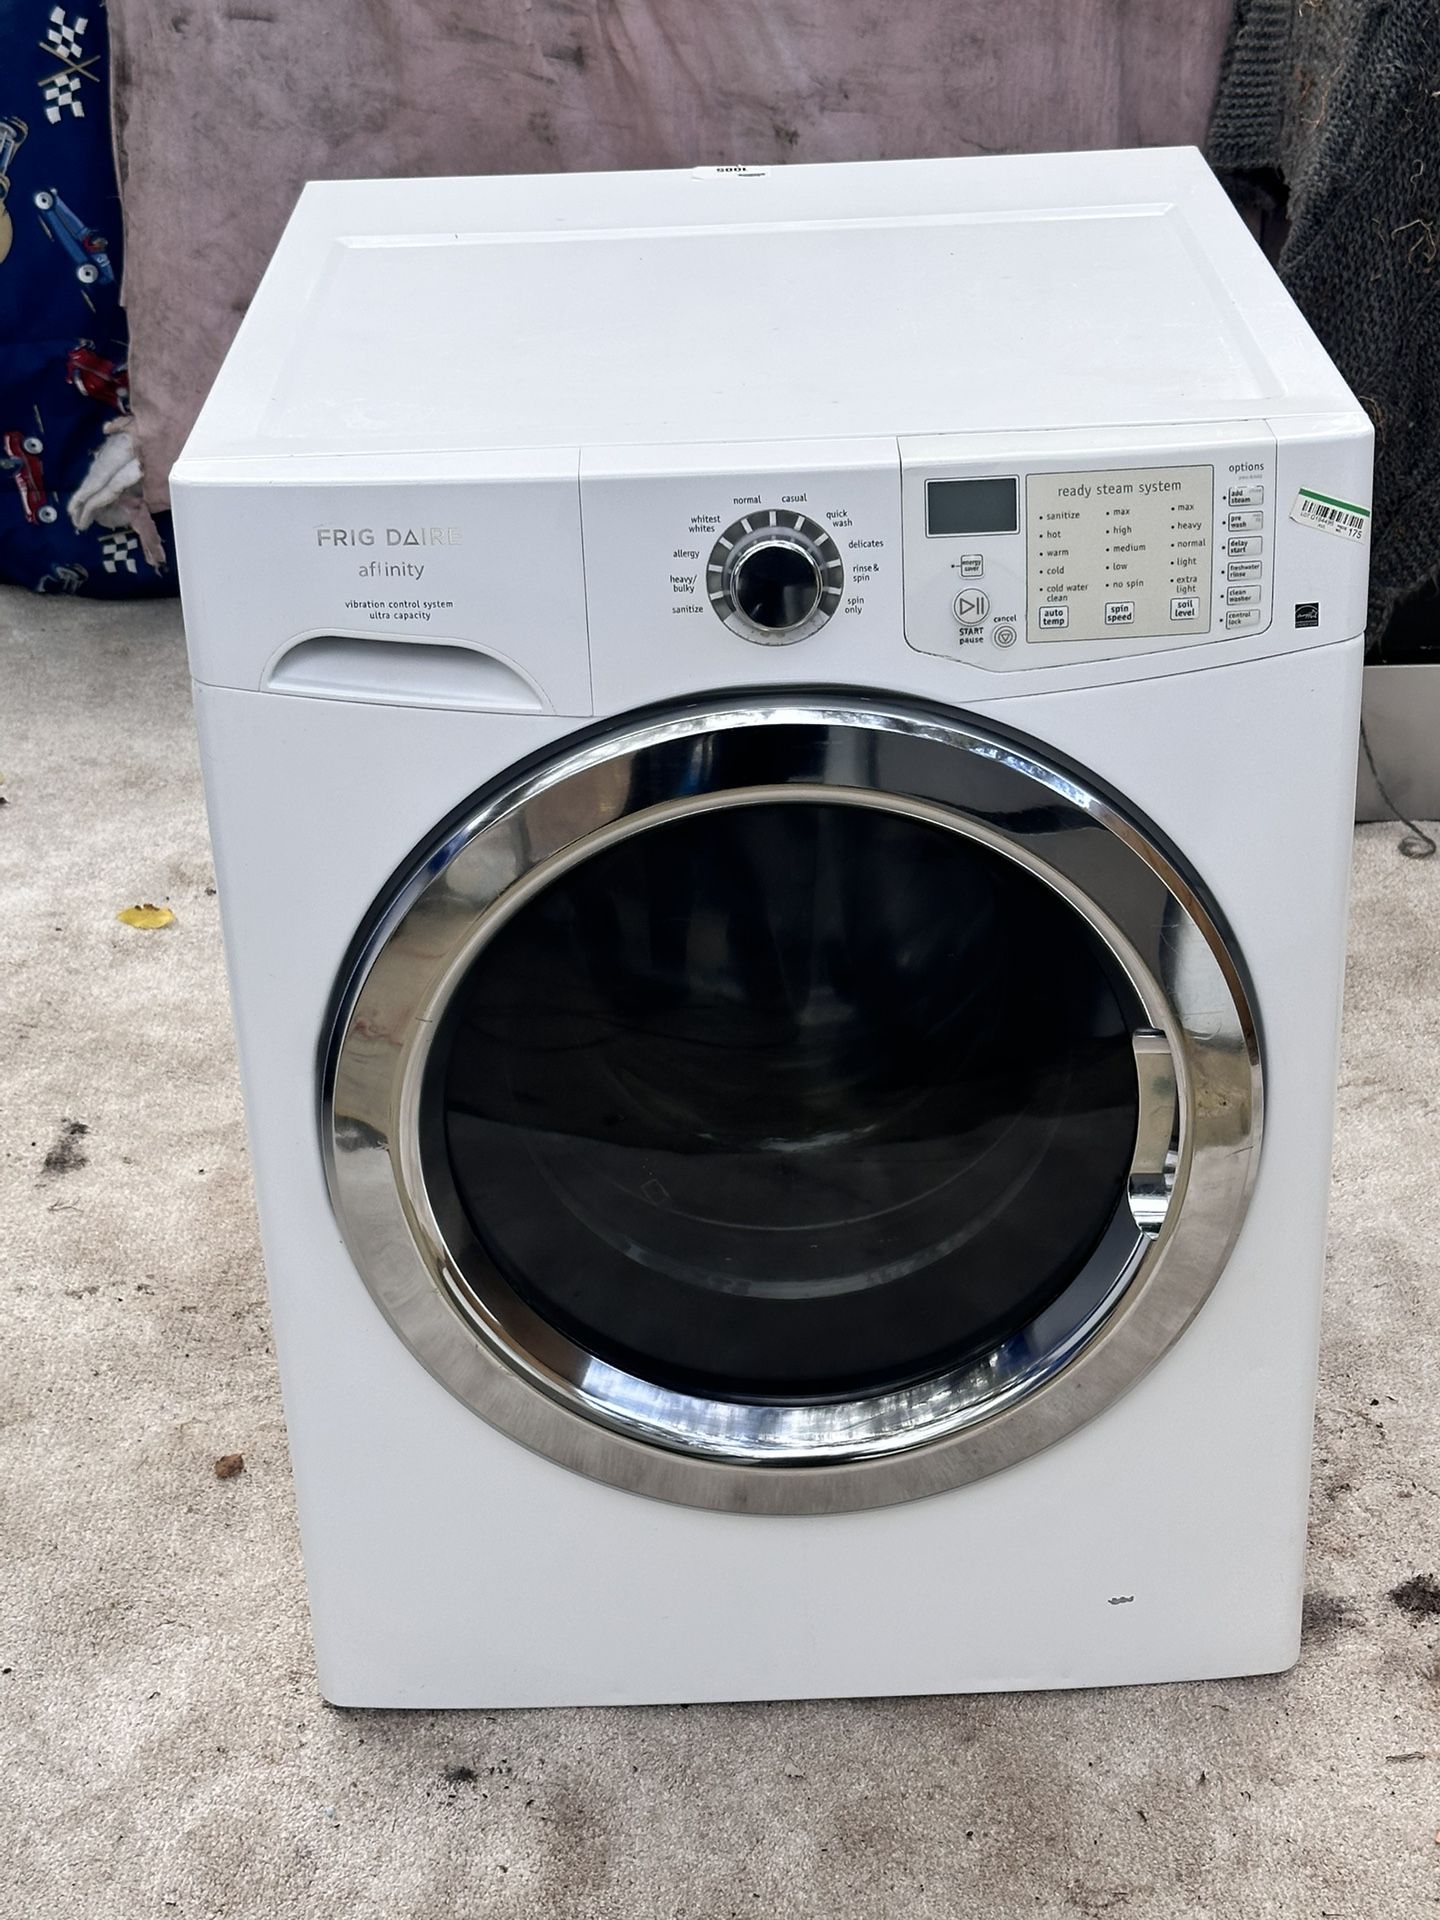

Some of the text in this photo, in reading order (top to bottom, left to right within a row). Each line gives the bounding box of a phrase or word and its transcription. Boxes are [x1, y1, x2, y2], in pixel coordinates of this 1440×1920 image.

[1229, 463, 1264, 473] options
[1058, 480, 1181, 498] ready steam system
[733, 495, 761, 504] normal
[781, 493, 807, 503] casual
[691, 514, 721, 523] whitest
[826, 509, 848, 519] quick
[1047, 511, 1080, 520] sanitize
[832, 518, 853, 527] wash
[1177, 522, 1202, 530] heavy
[1113, 526, 1132, 534] high
[1348, 529, 1362, 538] 175
[848, 540, 884, 548] delicates
[1177, 539, 1206, 547] normal
[1114, 544, 1146, 552] medium
[673, 550, 700, 559] allergy
[962, 559, 981, 567] energy
[1177, 557, 1197, 566] light
[853, 565, 872, 573] rinse
[670, 575, 697, 584] heavy/
[853, 574, 870, 582] spin
[1113, 579, 1144, 588] no spin
[673, 584, 695, 593] bulky
[1176, 585, 1196, 593] light
[847, 596, 865, 606] spin
[1047, 594, 1068, 602] clean
[345, 600, 453, 610] vibration control system
[672, 605, 703, 614] sanitize
[1111, 605, 1129, 614] spin
[1177, 601, 1193, 609] soil
[845, 605, 863, 615] only
[1175, 609, 1195, 617] level
[370, 611, 431, 621] ultra capacity
[1107, 613, 1132, 622] speed
[1043, 617, 1064, 626] temp
[959, 627, 983, 635] START
[959, 637, 984, 645] pause
